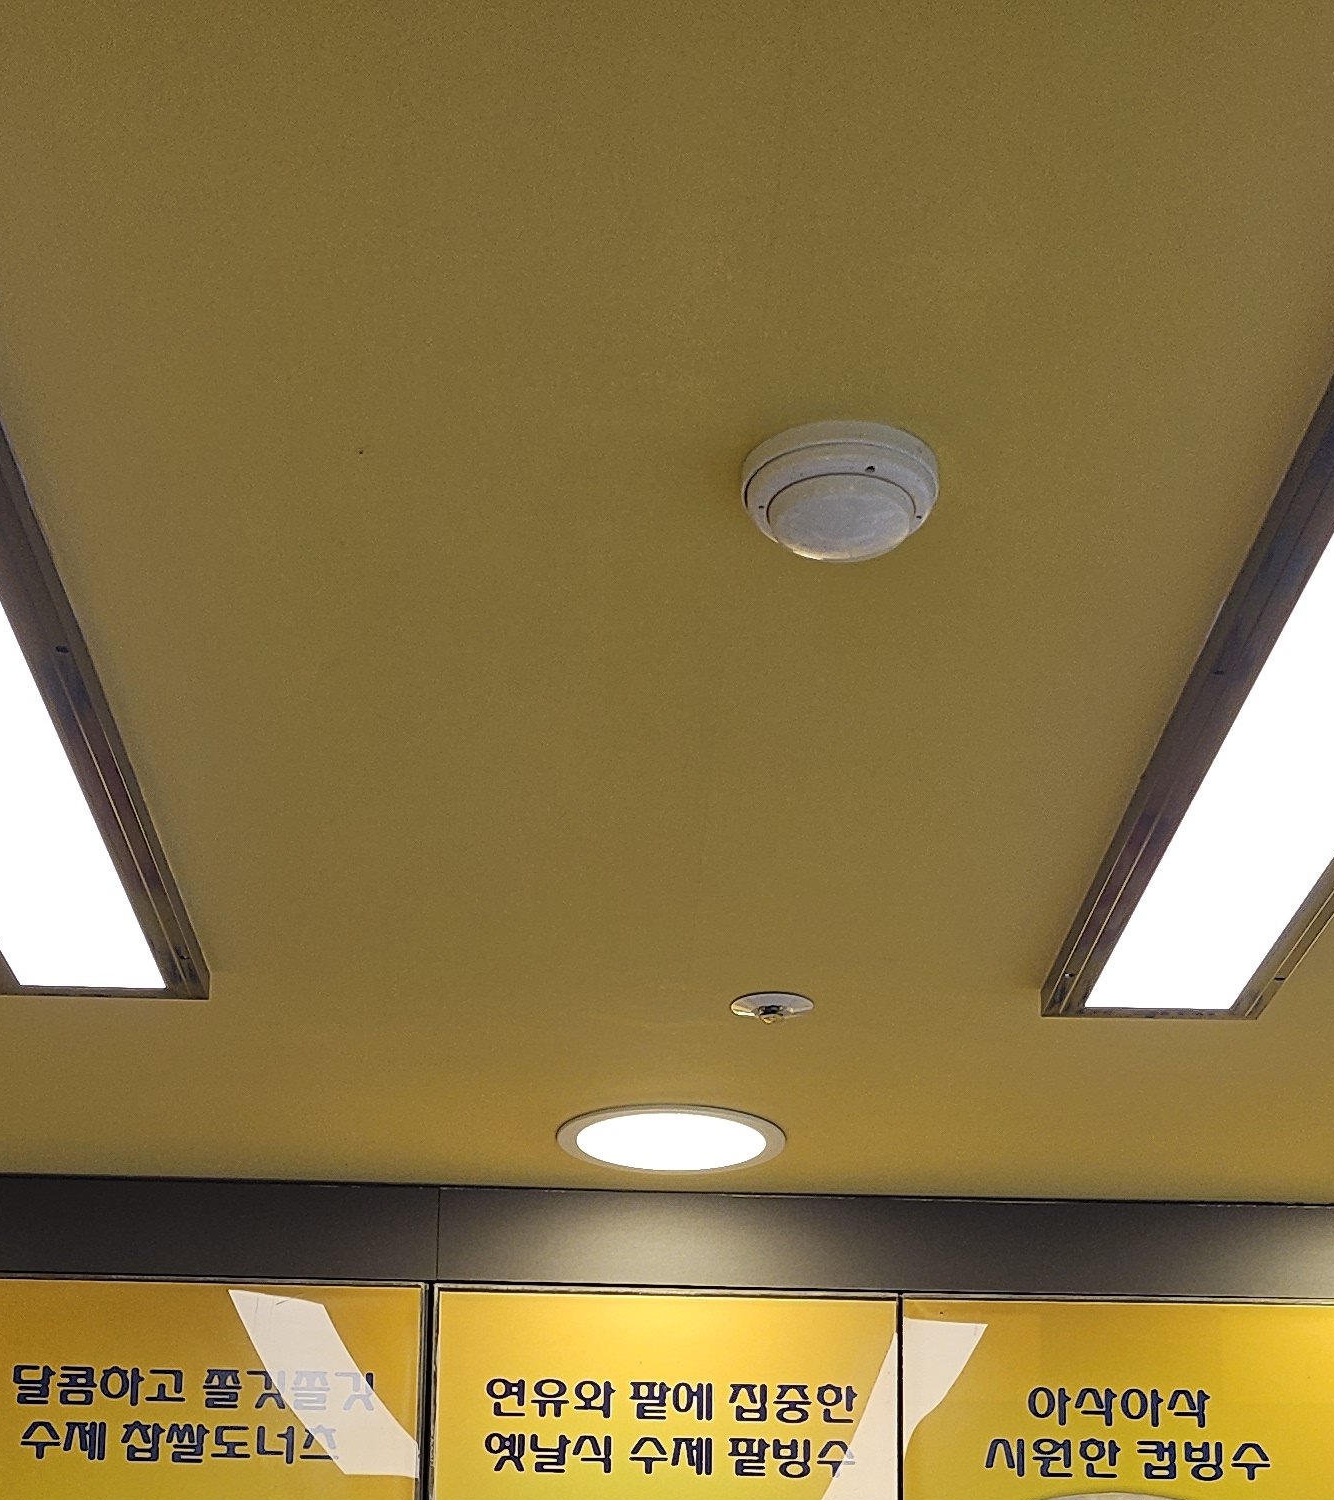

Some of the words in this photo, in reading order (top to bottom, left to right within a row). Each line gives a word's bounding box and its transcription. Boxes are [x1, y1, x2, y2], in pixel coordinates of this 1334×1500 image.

[12, 1364, 186, 1407] 달콤하고
[202, 1368, 374, 1411] 쫄깃쫄깃
[485, 1378, 616, 1419] 연유와
[629, 1381, 713, 1421] 팥에
[728, 1383, 858, 1424] 집중한
[1027, 1386, 1211, 1428] 아삭아삭
[19, 1420, 107, 1461] 수제
[121, 1420, 339, 1465] 찹쌀도너츠
[484, 1432, 612, 1473] 옛날식
[629, 1436, 713, 1475] 수제
[728, 1437, 856, 1479] 팥빙수
[984, 1438, 1121, 1478] 시원한
[1137, 1440, 1271, 1482] 컵빙수
